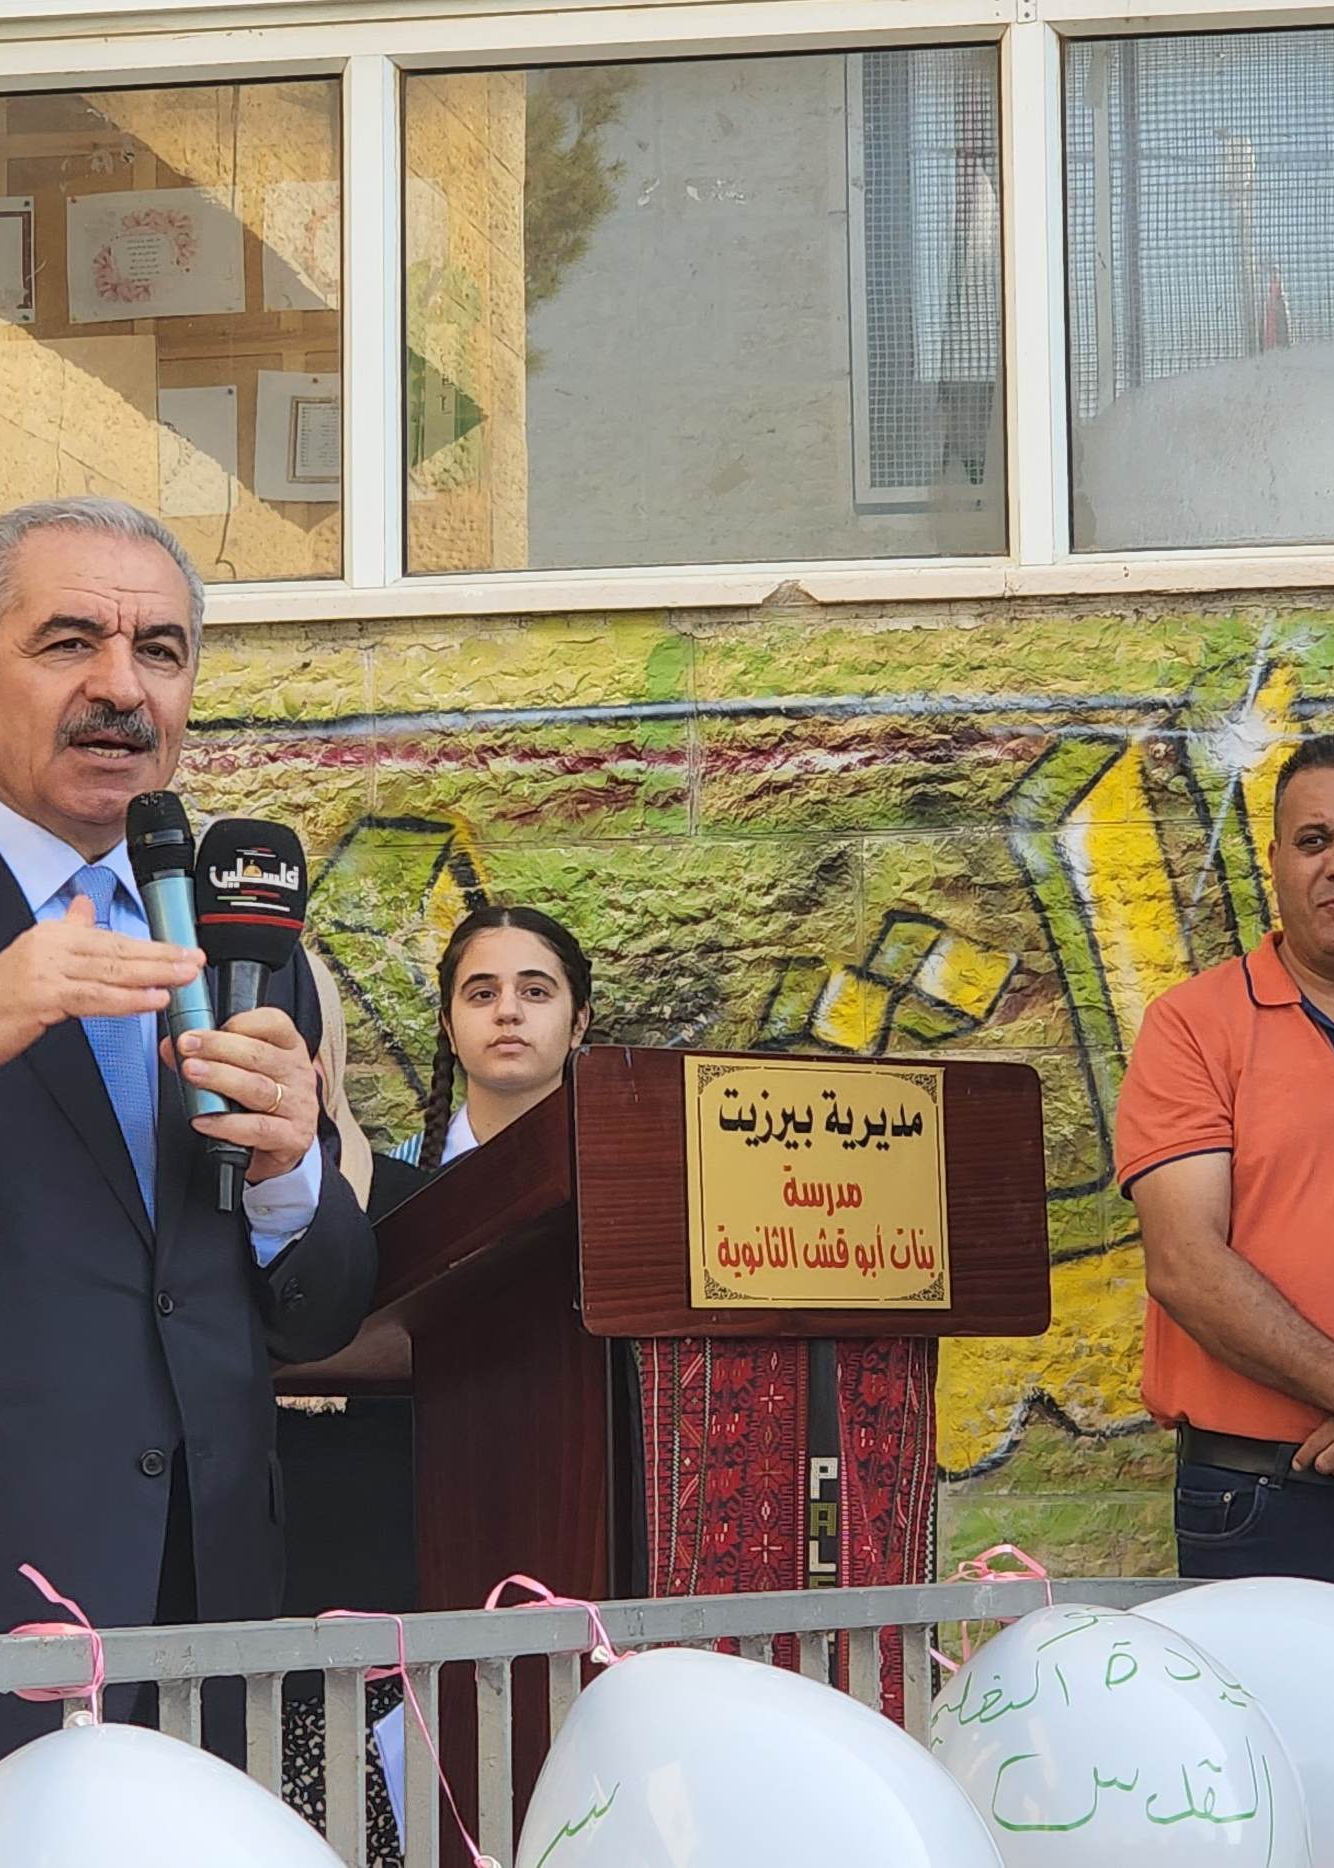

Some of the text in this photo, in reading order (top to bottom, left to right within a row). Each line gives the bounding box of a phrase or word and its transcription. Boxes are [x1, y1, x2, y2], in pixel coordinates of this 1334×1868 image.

[718, 1087, 924, 1151] مديرية بيرزيت
[782, 1165, 863, 1216] مدرسة
[717, 1224, 936, 1279] بنات أبو قش الثانوية
[991, 1732, 1274, 1868] القدس
